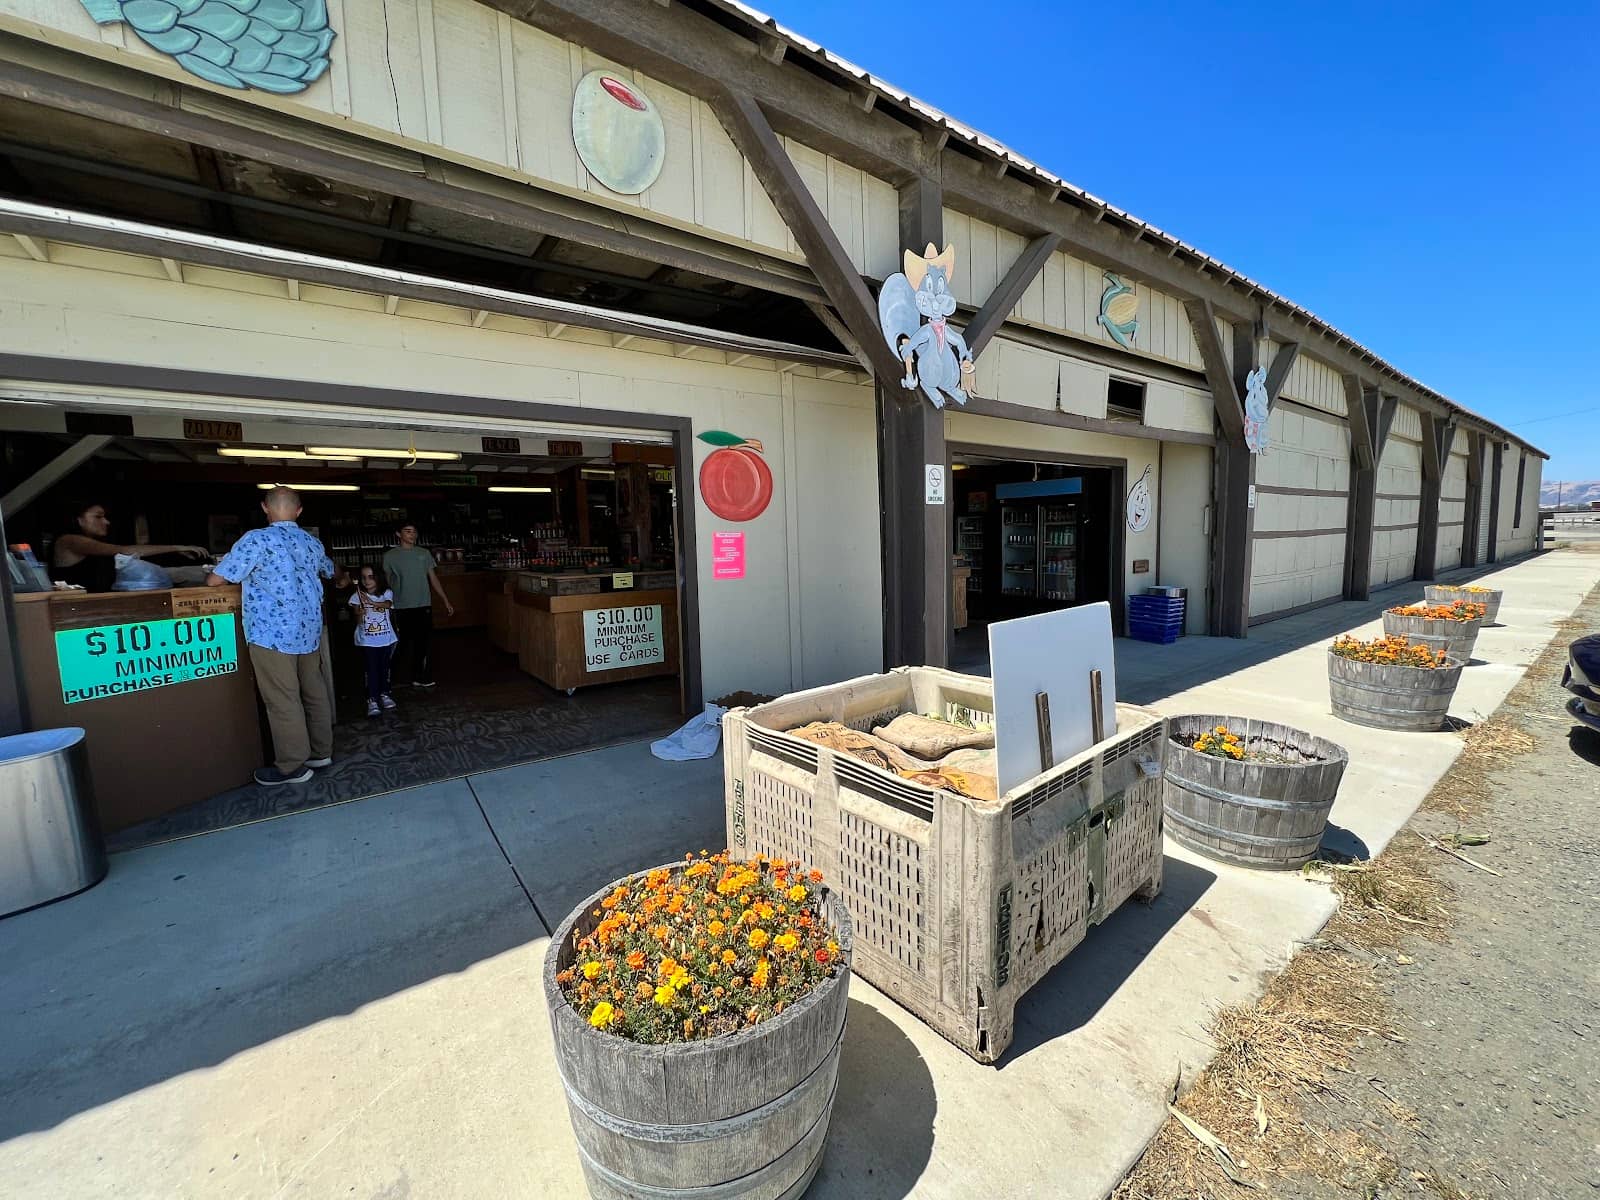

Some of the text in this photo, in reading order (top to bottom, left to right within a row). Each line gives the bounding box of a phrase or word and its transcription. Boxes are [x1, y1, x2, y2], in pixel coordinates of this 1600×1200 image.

[597, 606, 653, 625] $10.00
[85, 617, 216, 657] $10.00
[594, 632, 655, 648] PURCHASE
[597, 624, 646, 637] MINIMUM
[115, 646, 223, 678] MINIMUM
[587, 647, 659, 666] USE CARDS
[64, 673, 175, 703] PURCHASE
[194, 660, 237, 678] CARD
